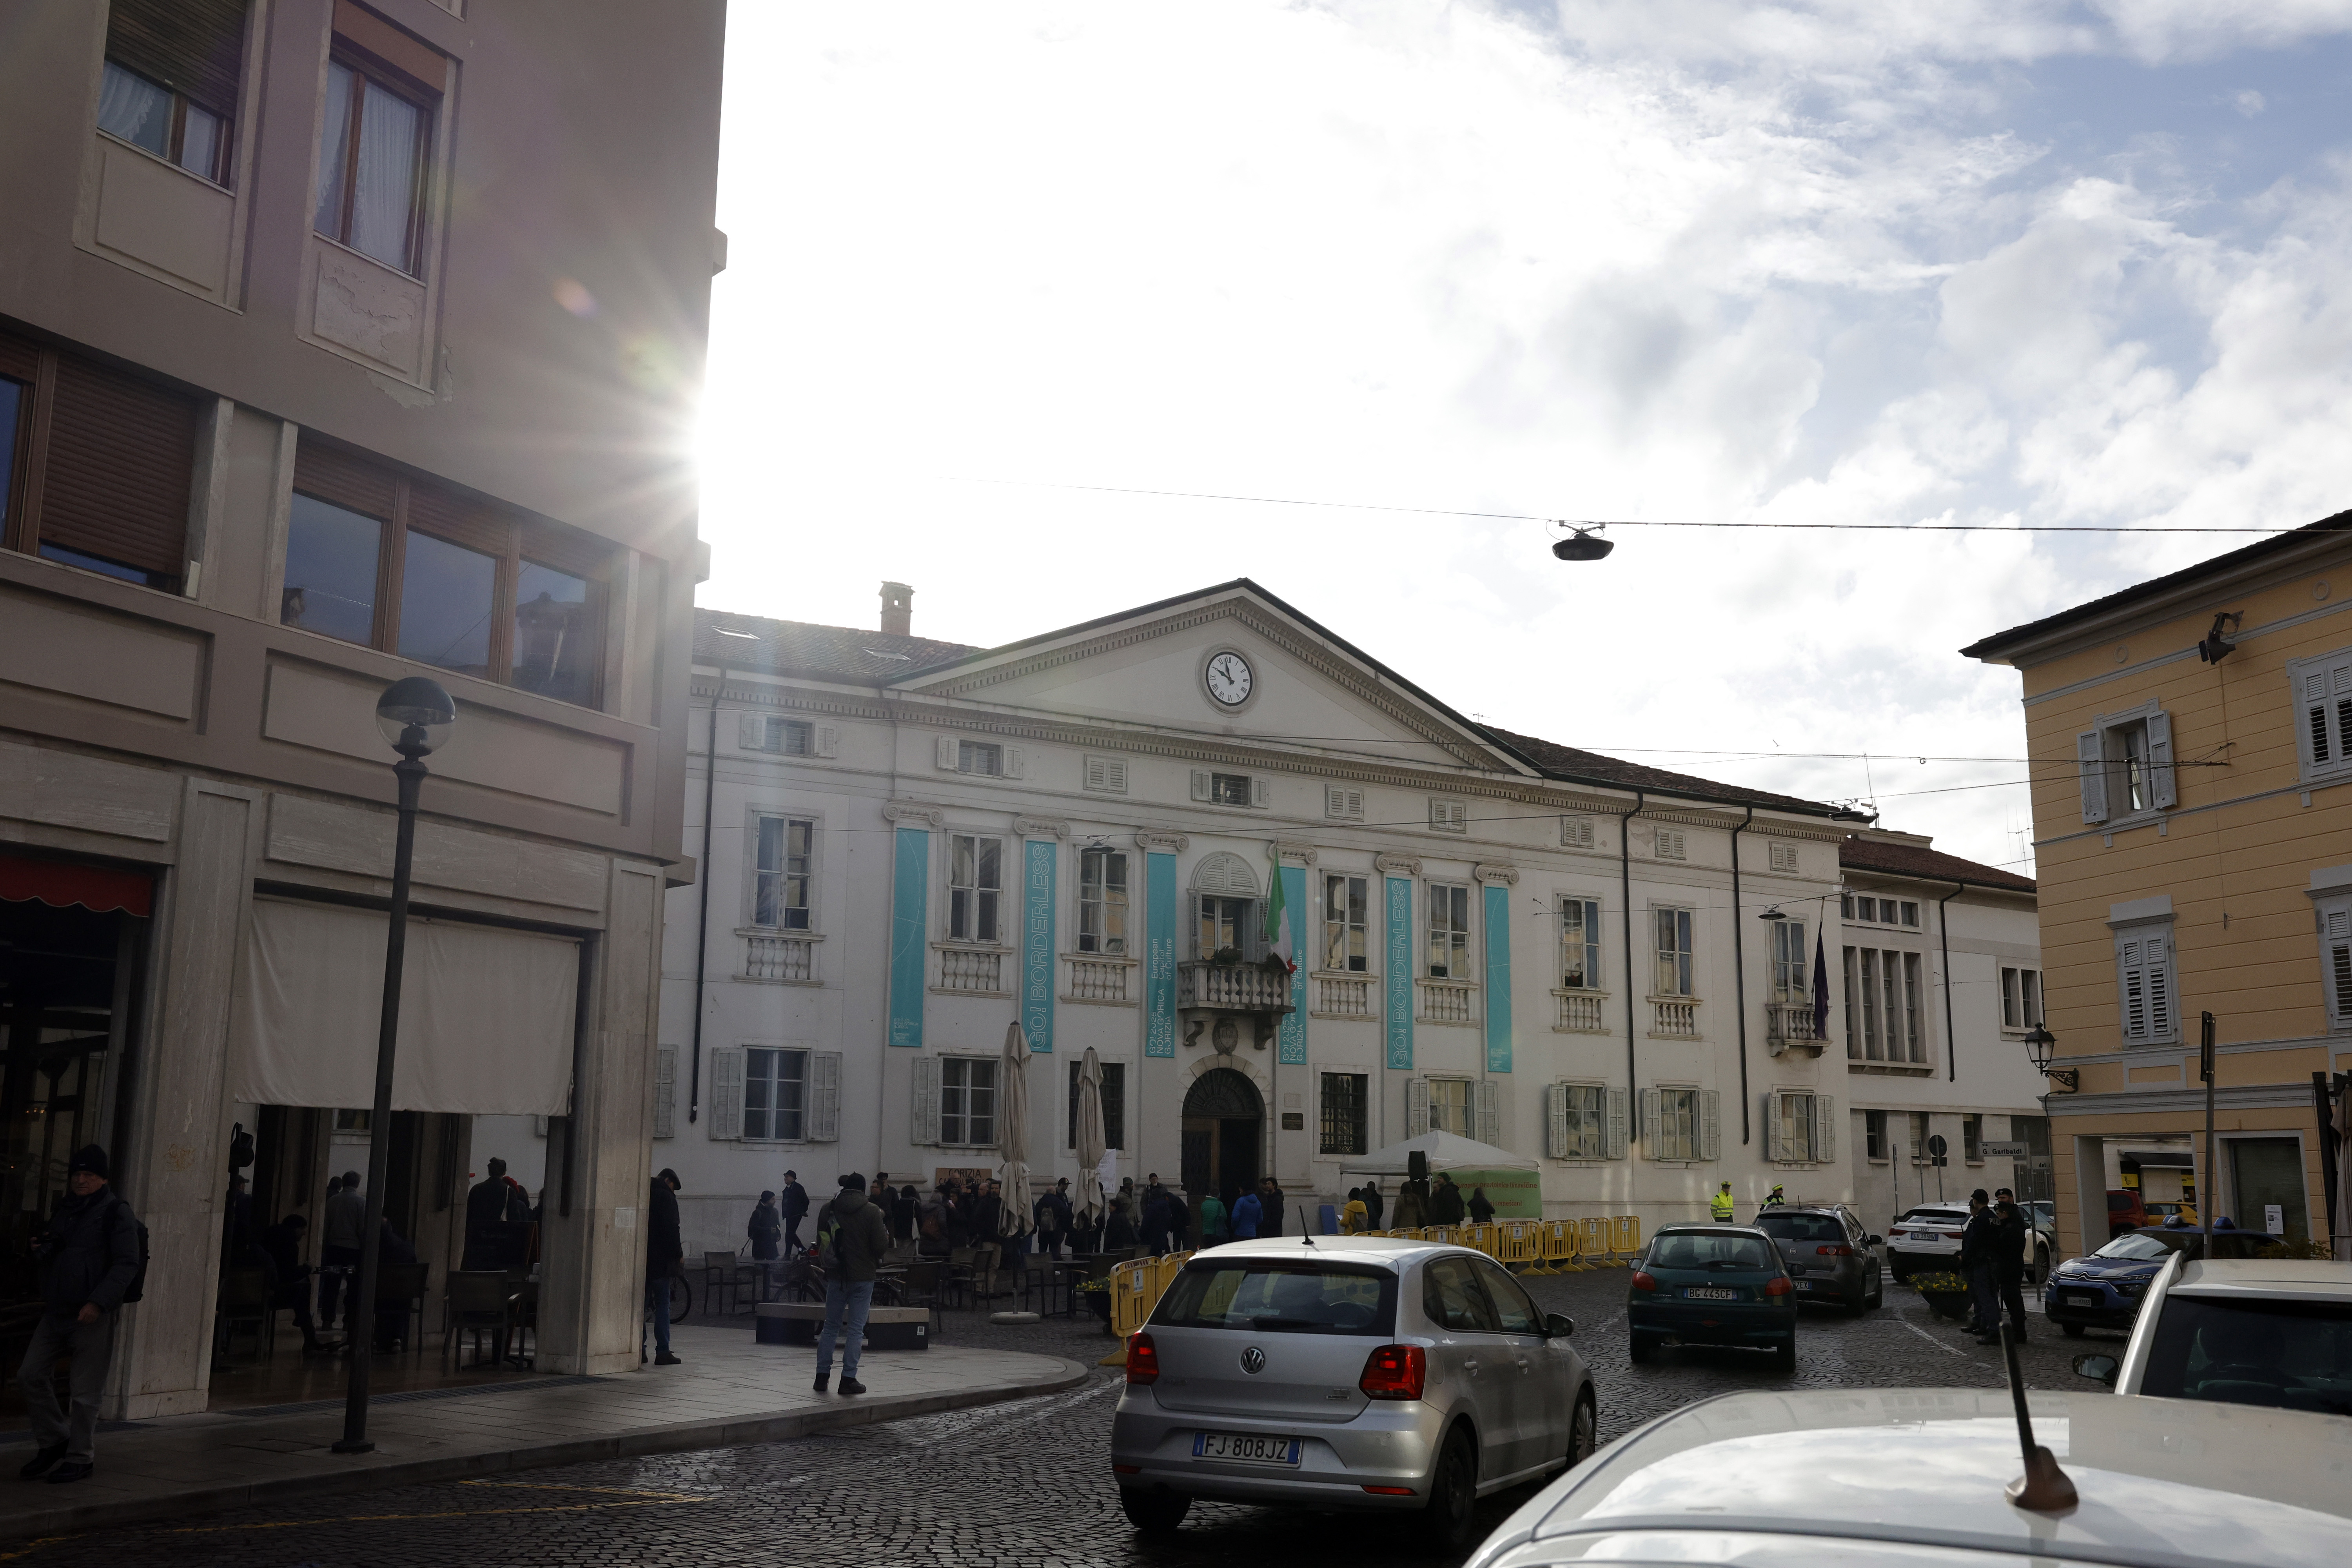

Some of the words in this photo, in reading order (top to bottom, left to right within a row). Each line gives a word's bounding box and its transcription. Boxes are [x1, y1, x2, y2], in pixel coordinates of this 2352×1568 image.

[1030, 844, 1049, 1001] BORDERLESS
[1392, 881, 1406, 1023] BORDERLESS
[1165, 972, 1171, 980] of
[1296, 982, 1303, 990] of
[1029, 1006, 1047, 1049] GO!
[1393, 1029, 1407, 1066] GO!
[1689, 1289, 1700, 1298] BG
[1703, 1289, 1731, 1298] 443CF
[1205, 1435, 1227, 1455] FJ
[1232, 1437, 1288, 1460] 808JZ
